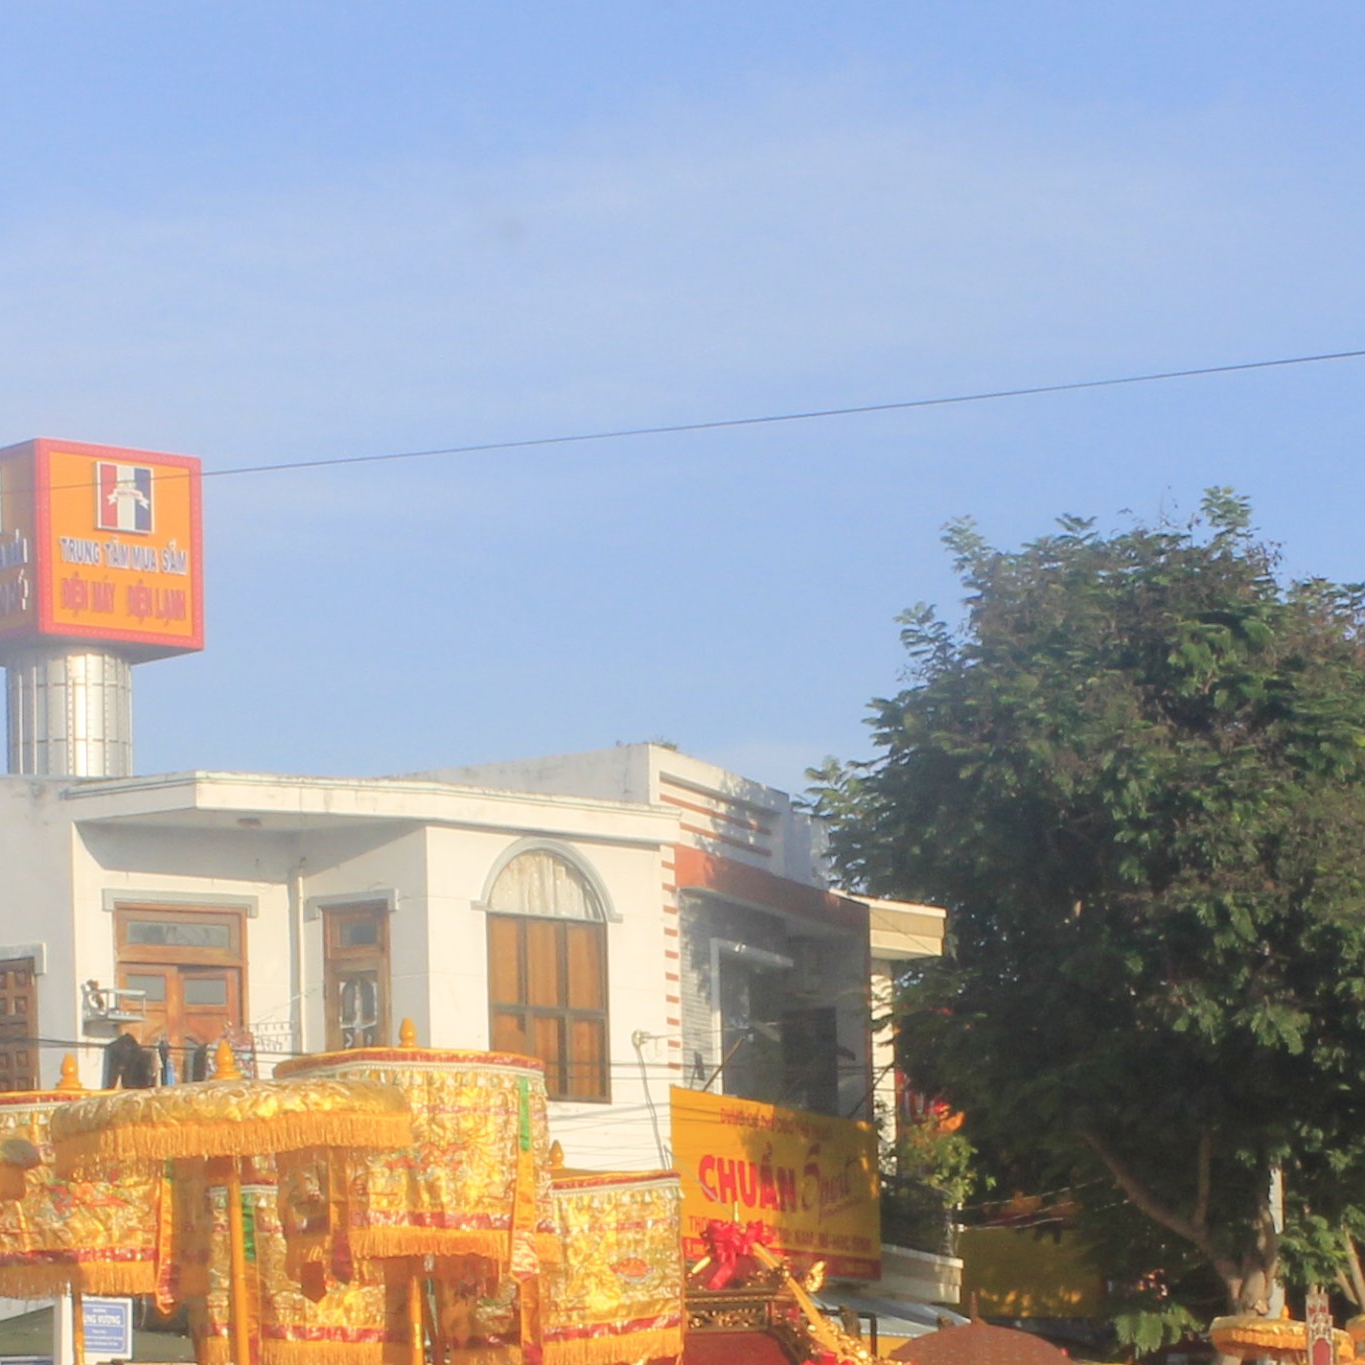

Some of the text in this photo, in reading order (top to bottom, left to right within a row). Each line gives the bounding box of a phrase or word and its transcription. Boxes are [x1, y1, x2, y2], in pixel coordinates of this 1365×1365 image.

[59, 536, 101, 567] TRUNG
[103, 534, 130, 570] TÂM
[131, 545, 159, 573] MUA
